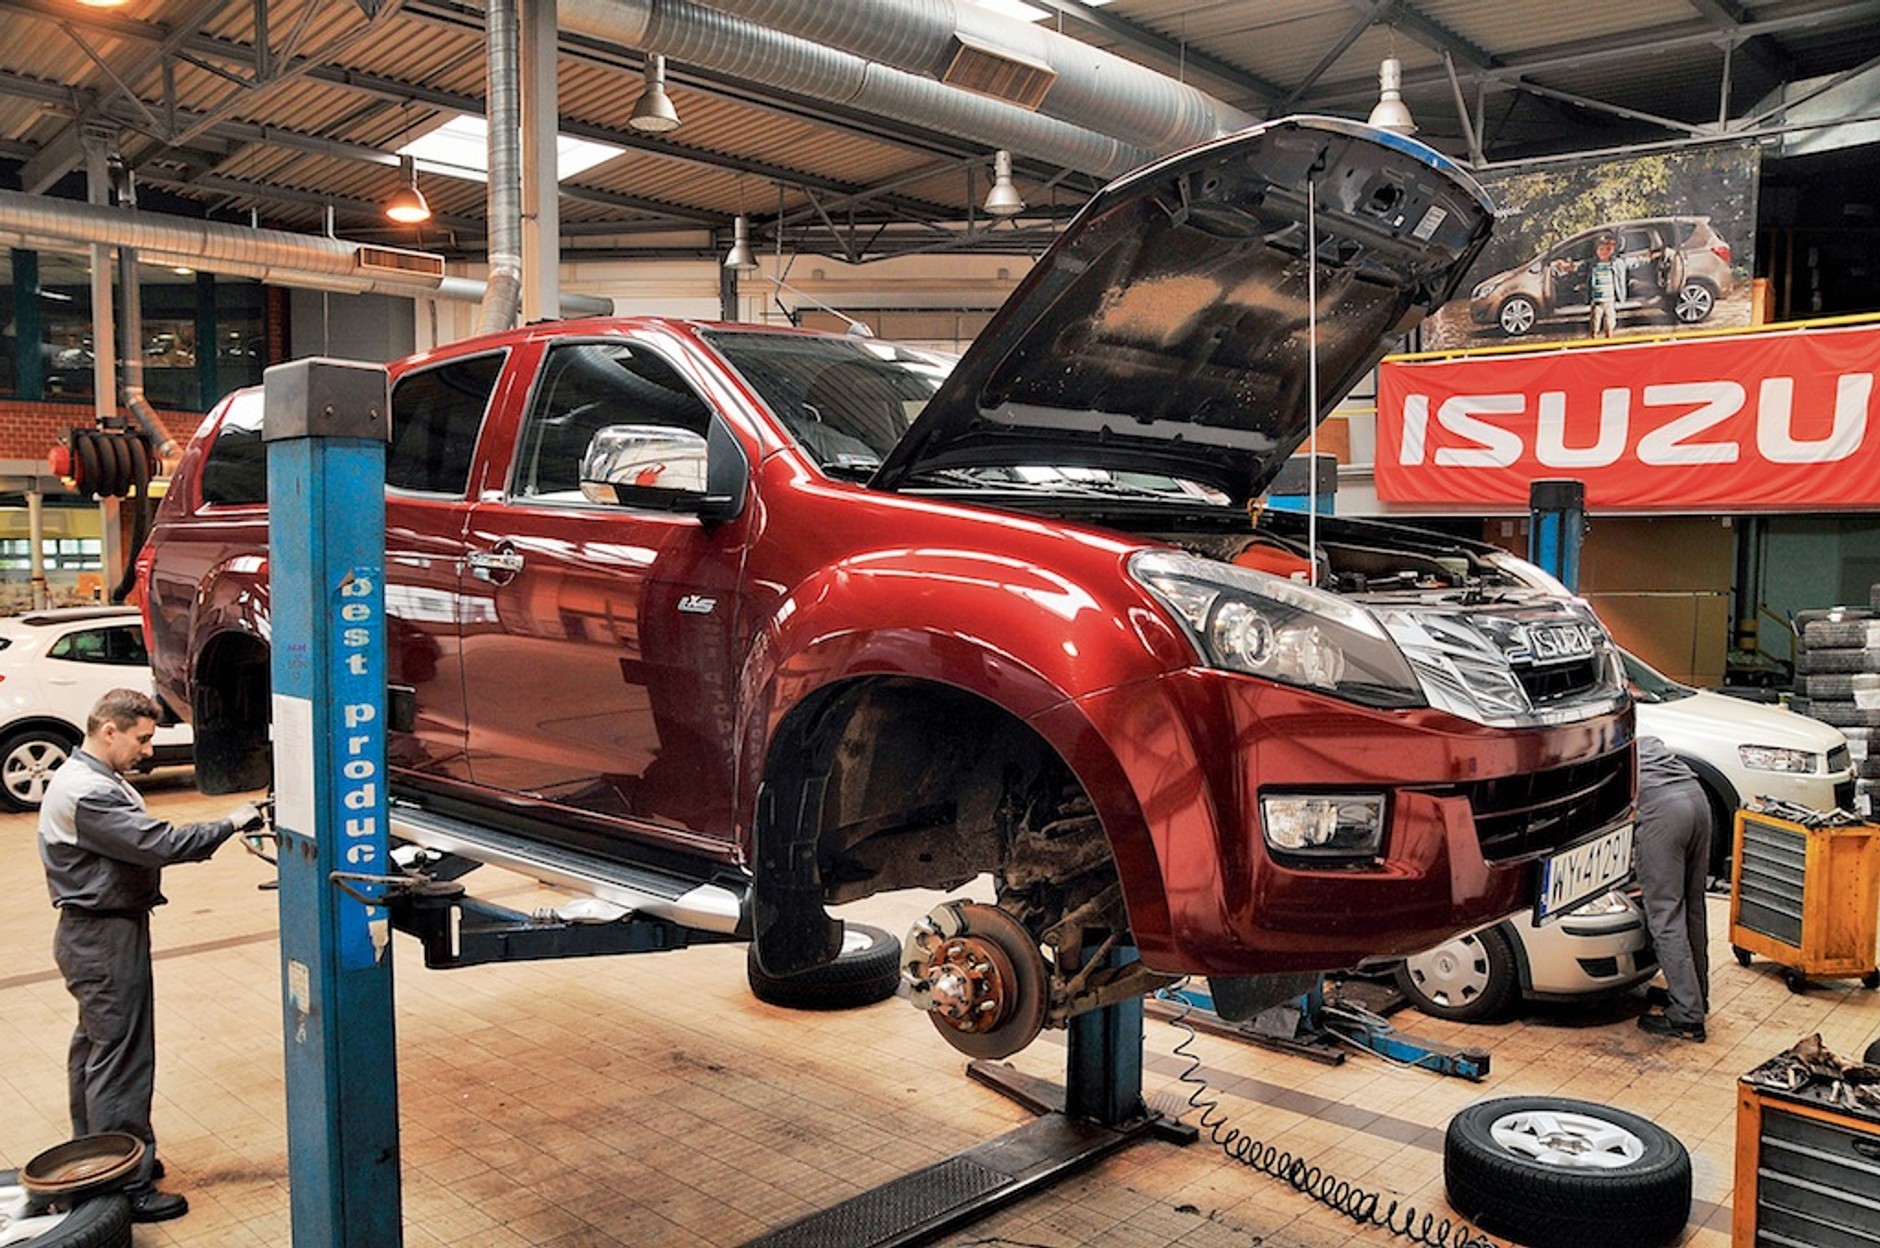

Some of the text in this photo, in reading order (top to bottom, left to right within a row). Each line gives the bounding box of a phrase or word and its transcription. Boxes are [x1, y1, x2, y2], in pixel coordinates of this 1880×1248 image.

[1399, 372, 1874, 468] ISUZU
[1529, 624, 1594, 659] ISUZU
[341, 577, 377, 917] best produc
